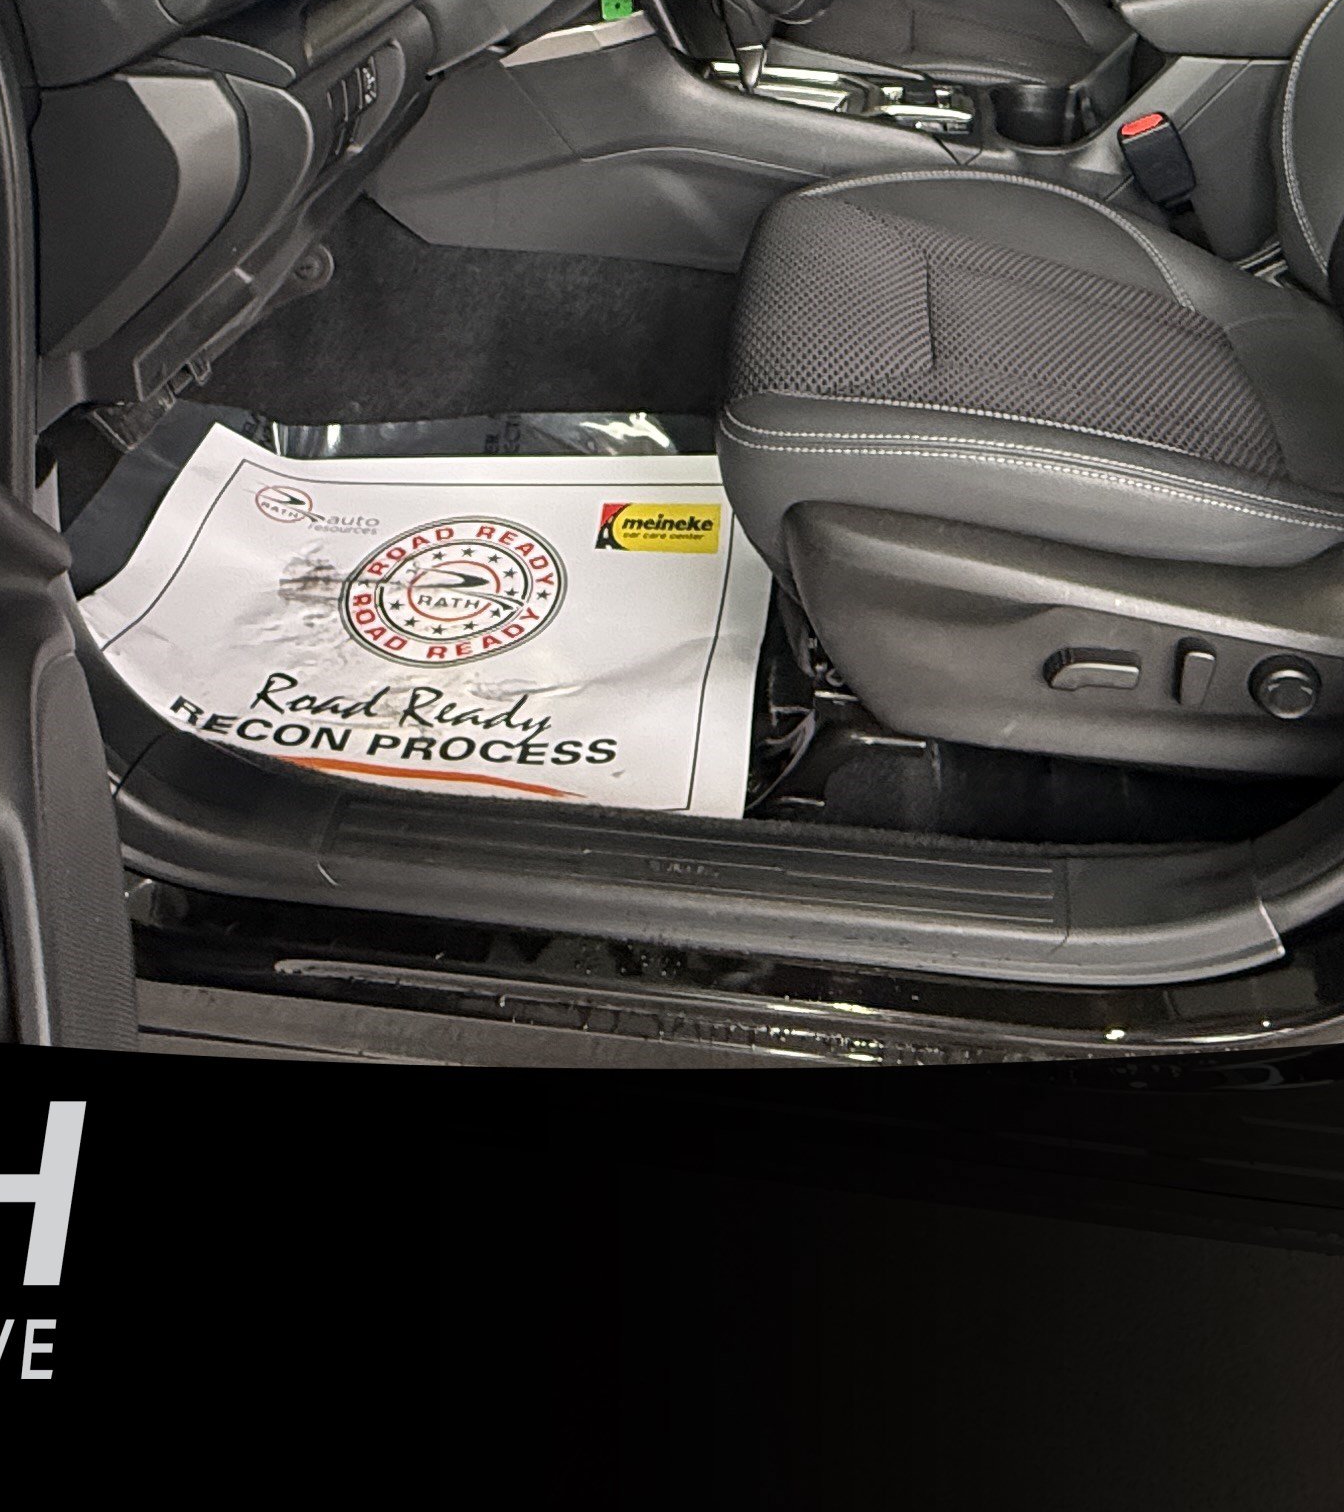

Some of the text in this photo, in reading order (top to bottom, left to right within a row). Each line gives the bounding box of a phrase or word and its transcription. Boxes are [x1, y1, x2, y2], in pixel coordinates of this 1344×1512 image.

[307, 523, 378, 536] resources
[327, 515, 380, 528] auto
[621, 512, 714, 532] meineke
[367, 524, 555, 586] ROAD READY
[416, 594, 481, 610] RATH
[352, 593, 540, 660] ROAD READY
[250, 671, 553, 747] Road Ready
[169, 695, 619, 766] RECON PROCESS
